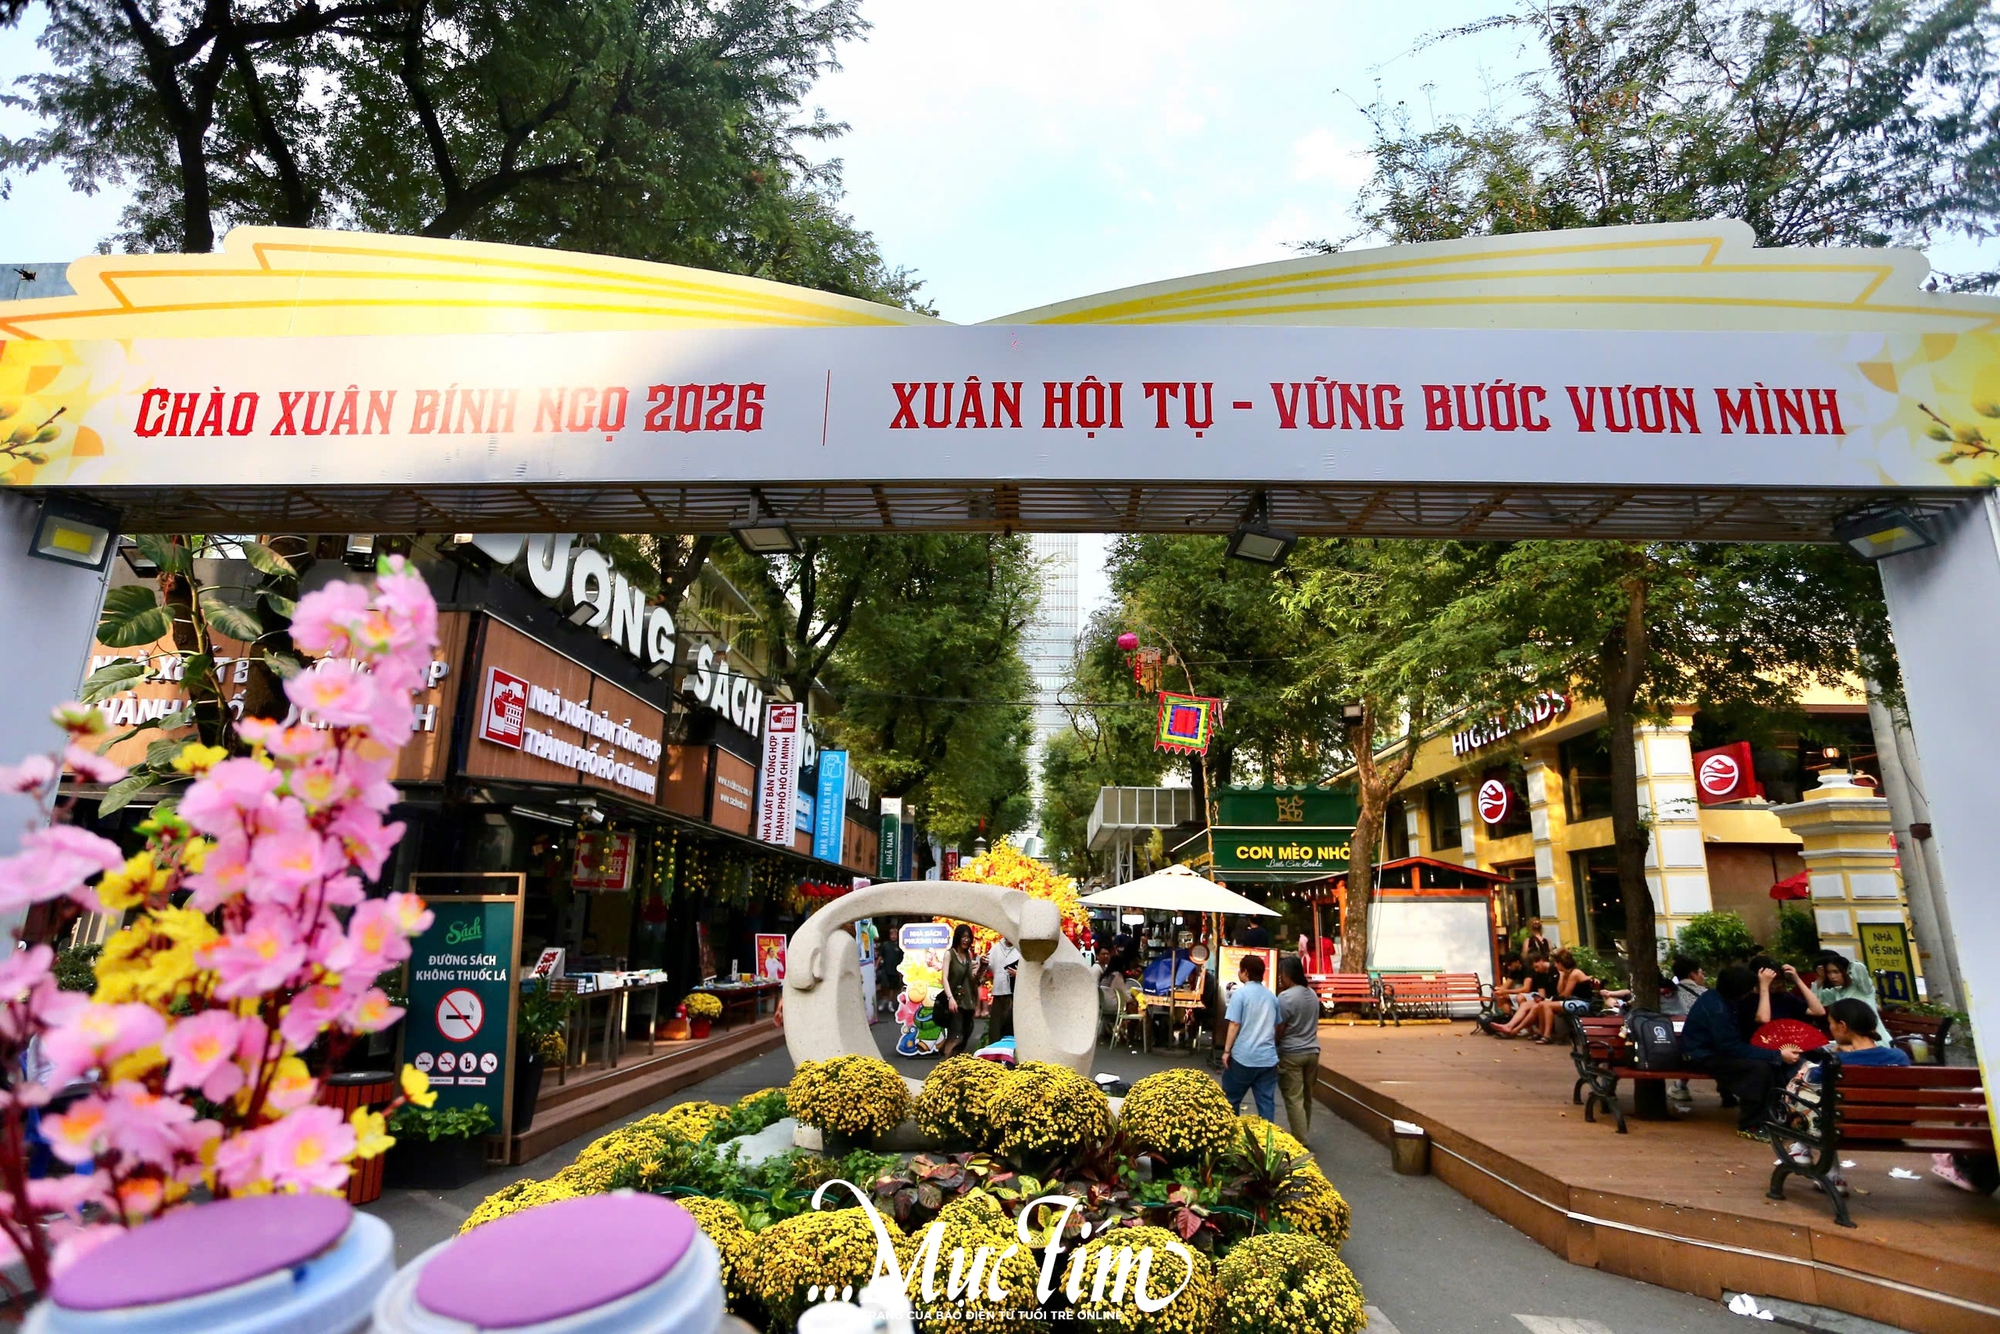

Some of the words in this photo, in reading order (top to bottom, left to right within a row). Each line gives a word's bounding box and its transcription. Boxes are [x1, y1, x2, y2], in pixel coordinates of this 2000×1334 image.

[133, 386, 260, 438] CHÀO
[270, 384, 398, 435] XUÂN
[409, 383, 519, 434] BÍNH
[532, 386, 630, 442] NGỌ
[643, 382, 767, 433] 2026
[889, 375, 1023, 429] XUÂN
[1042, 375, 1123, 438] HỘI
[1142, 382, 1214, 438] TỤ
[1269, 376, 1405, 431] VỮNG
[1421, 378, 1552, 432] BƯỚC
[1566, 384, 1701, 434] VƯƠN
[1713, 381, 1846, 435] MÌNH
[688, 641, 764, 738] SÁCH
[528, 685, 561, 720] NHÀ
[559, 700, 595, 732] XUẤT
[589, 711, 617, 743] BẢN
[614, 719, 643, 754] TỔNG
[641, 737, 662, 765] HỢP
[769, 735, 779, 753] HỢP
[781, 737, 790, 759] MINH
[523, 727, 573, 768] THÀNH
[570, 743, 600, 774] PHỐ
[595, 749, 616, 780] HỒ
[614, 762, 635, 786] CHÍ
[632, 768, 656, 795] MINH
[765, 755, 777, 778] TỔNG
[779, 761, 789, 775] CHÍ
[764, 780, 775, 797] BẢN
[778, 777, 788, 790] HỒ
[763, 798, 774, 821] XUẤT
[776, 792, 786, 810] PHỐ
[821, 799, 831, 814] BẢN
[762, 823, 773, 842] NHÀ
[774, 812, 785, 841] THÀNH
[820, 817, 829, 836] XUẤT
[819, 839, 828, 855] NHÀ
[886, 832, 894, 848] NAM
[1236, 846, 1273, 859] CON
[1278, 842, 1313, 860] MÈO
[1317, 842, 1350, 860] NHỎ
[446, 916, 482, 944] Sách
[1872, 931, 1893, 942] NHÀ
[1868, 943, 1881, 956] VỆ
[1881, 945, 1903, 955] SINH
[428, 953, 467, 966] ĐƯỜNG
[469, 953, 496, 966] SÁCH
[1876, 959, 1899, 967] TOILET
[416, 969, 455, 981] KHÔNG
[456, 968, 492, 981] THUỐC
[494, 968, 507, 981] LÁ
